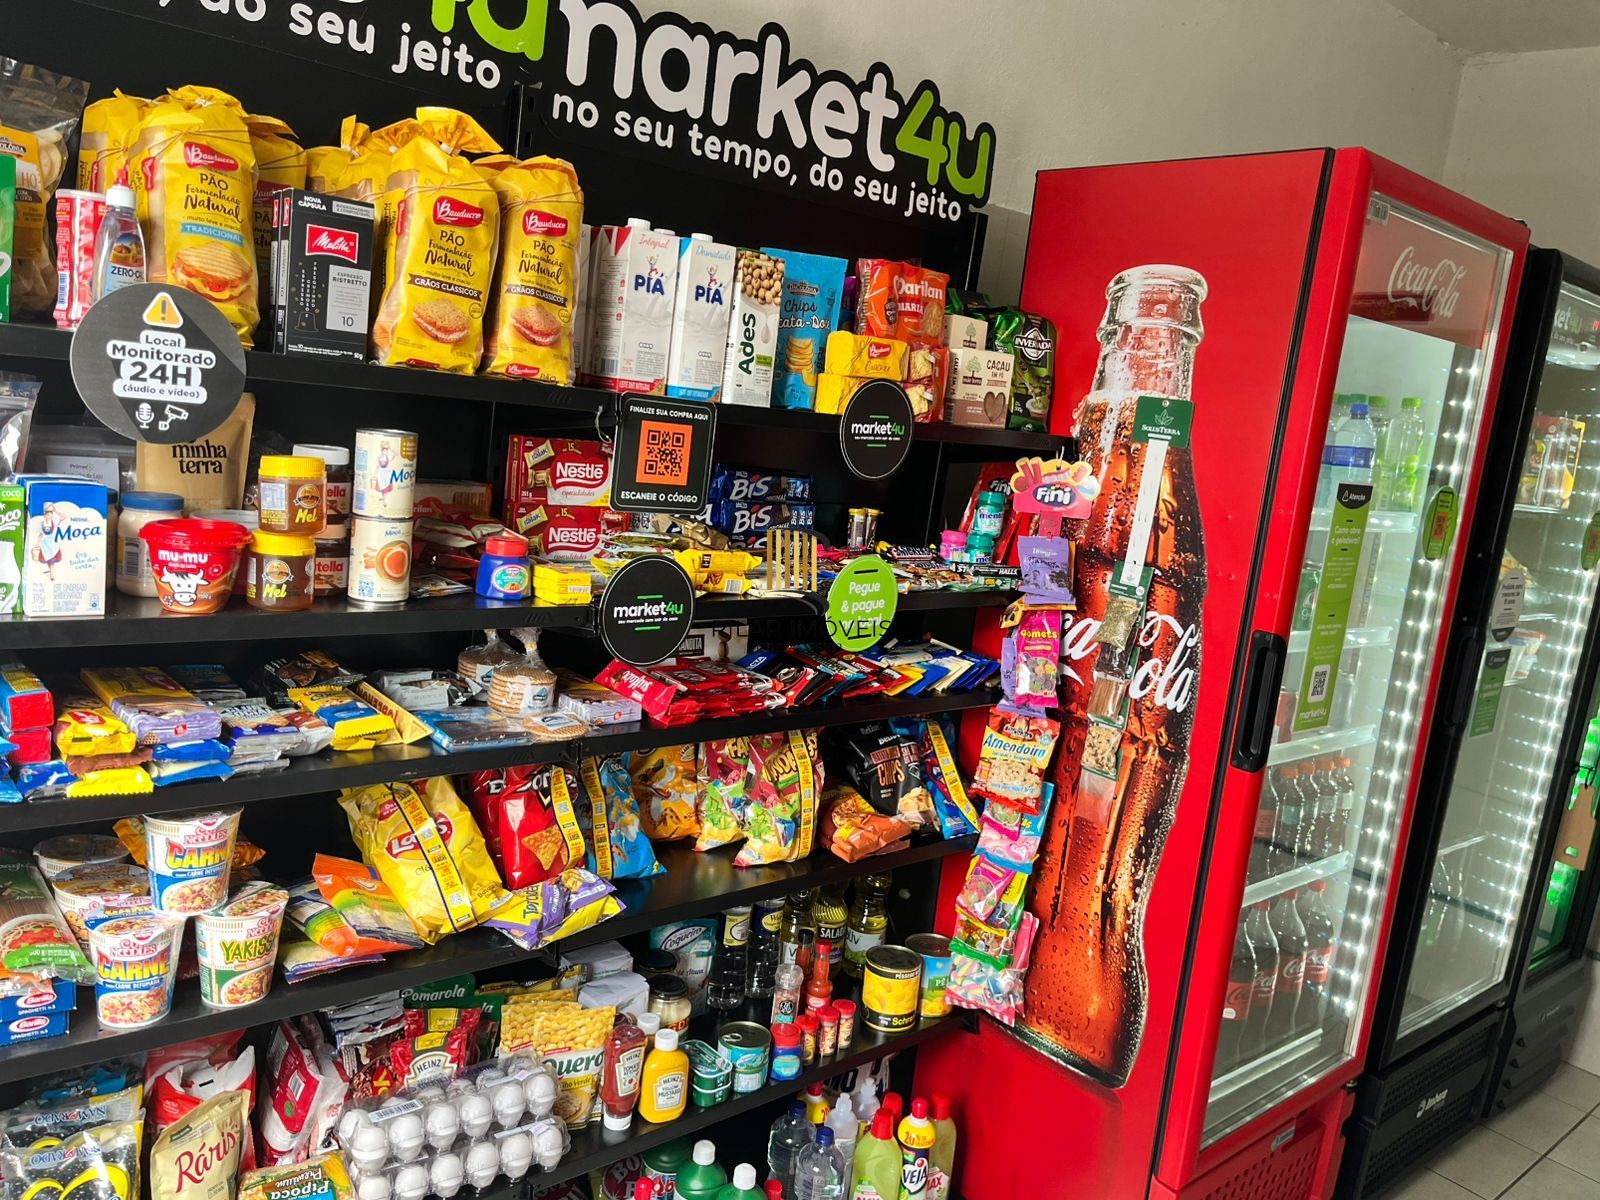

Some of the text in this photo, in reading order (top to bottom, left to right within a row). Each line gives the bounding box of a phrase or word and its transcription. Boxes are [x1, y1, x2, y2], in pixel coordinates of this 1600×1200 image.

[289, 3, 375, 54] seu
[392, 22, 501, 89] jeito
[186, 143, 236, 166] Bauducco
[552, 93, 962, 222] no seu tempo, do seu jeito
[199, 172, 229, 191] PÃO
[183, 194, 244, 225] Natural
[436, 199, 482, 223] Bauducco
[525, 211, 566, 233] Bauducco
[186, 224, 242, 243] TRADICIONAL
[439, 230, 465, 247] PÃO
[638, 233, 670, 250] Integral
[312, 231, 351, 254] Melitta
[428, 239, 473, 260] Fermentação
[533, 240, 556, 255] PÃO
[424, 249, 476, 277] Natural
[518, 259, 564, 285] Natural
[332, 276, 368, 288] RISTRETTO
[414, 276, 478, 298] GRÃOS CLÁSSICOS
[634, 272, 665, 296] PIÁ
[893, 274, 943, 301] Marilan
[1387, 245, 1467, 319] Coca-Cola
[510, 285, 565, 304] GRÃOS CLÁSSICOS
[694, 283, 723, 306] PIÁ
[783, 298, 817, 314] Chips
[341, 316, 354, 328] 10
[145, 334, 181, 347] Local
[738, 312, 756, 375] Ades
[112, 344, 213, 367] Monitorado
[129, 361, 192, 387] 24H
[986, 359, 1011, 373] CACAU
[122, 384, 156, 395] (áudio
[168, 388, 200, 399] vídeo)
[629, 405, 708, 421] FINALIZE SUA COMPRA AQUI
[851, 421, 905, 435] market4u
[172, 439, 227, 458] minha
[567, 442, 575, 452] 15
[179, 457, 223, 474] terra
[556, 461, 604, 480] Nestlé
[327, 486, 346, 498] ella
[620, 491, 698, 503] ESCANEIE O CÓDIGO
[1035, 486, 1071, 505] Fini
[1348, 493, 1366, 501] Atenção
[295, 507, 317, 524] Mel
[560, 508, 568, 518] 15
[55, 525, 102, 543] Moça
[548, 527, 597, 544] Nestlé
[158, 549, 209, 564] mu-mu
[263, 582, 288, 599] Mel
[848, 581, 881, 597] Pegue
[613, 601, 684, 618] market4u
[840, 598, 886, 614] & pague
[983, 732, 1046, 758] Amendoim
[877, 758, 905, 787] CHIPS
[183, 831, 228, 845] NOODLES
[664, 927, 703, 950] Coqueiro
[109, 944, 159, 958] NOODLES
[97, 947, 171, 982] CARNE
[27, 994, 55, 1005] Barilla
[400, 983, 467, 1002] Pomarola
[18, 1006, 47, 1015] SPAGHETTI
[20, 1017, 48, 1029] Barilla
[10, 1030, 39, 1040] SPAGHETTI
[416, 1058, 442, 1073] HEINZ
[573, 1078, 591, 1087] Verde
[662, 1075, 680, 1085] HEINZ
[174, 1130, 238, 1194] Ráris
[903, 1165, 928, 1185] VEJA
[270, 1180, 330, 1200] Pipoca
